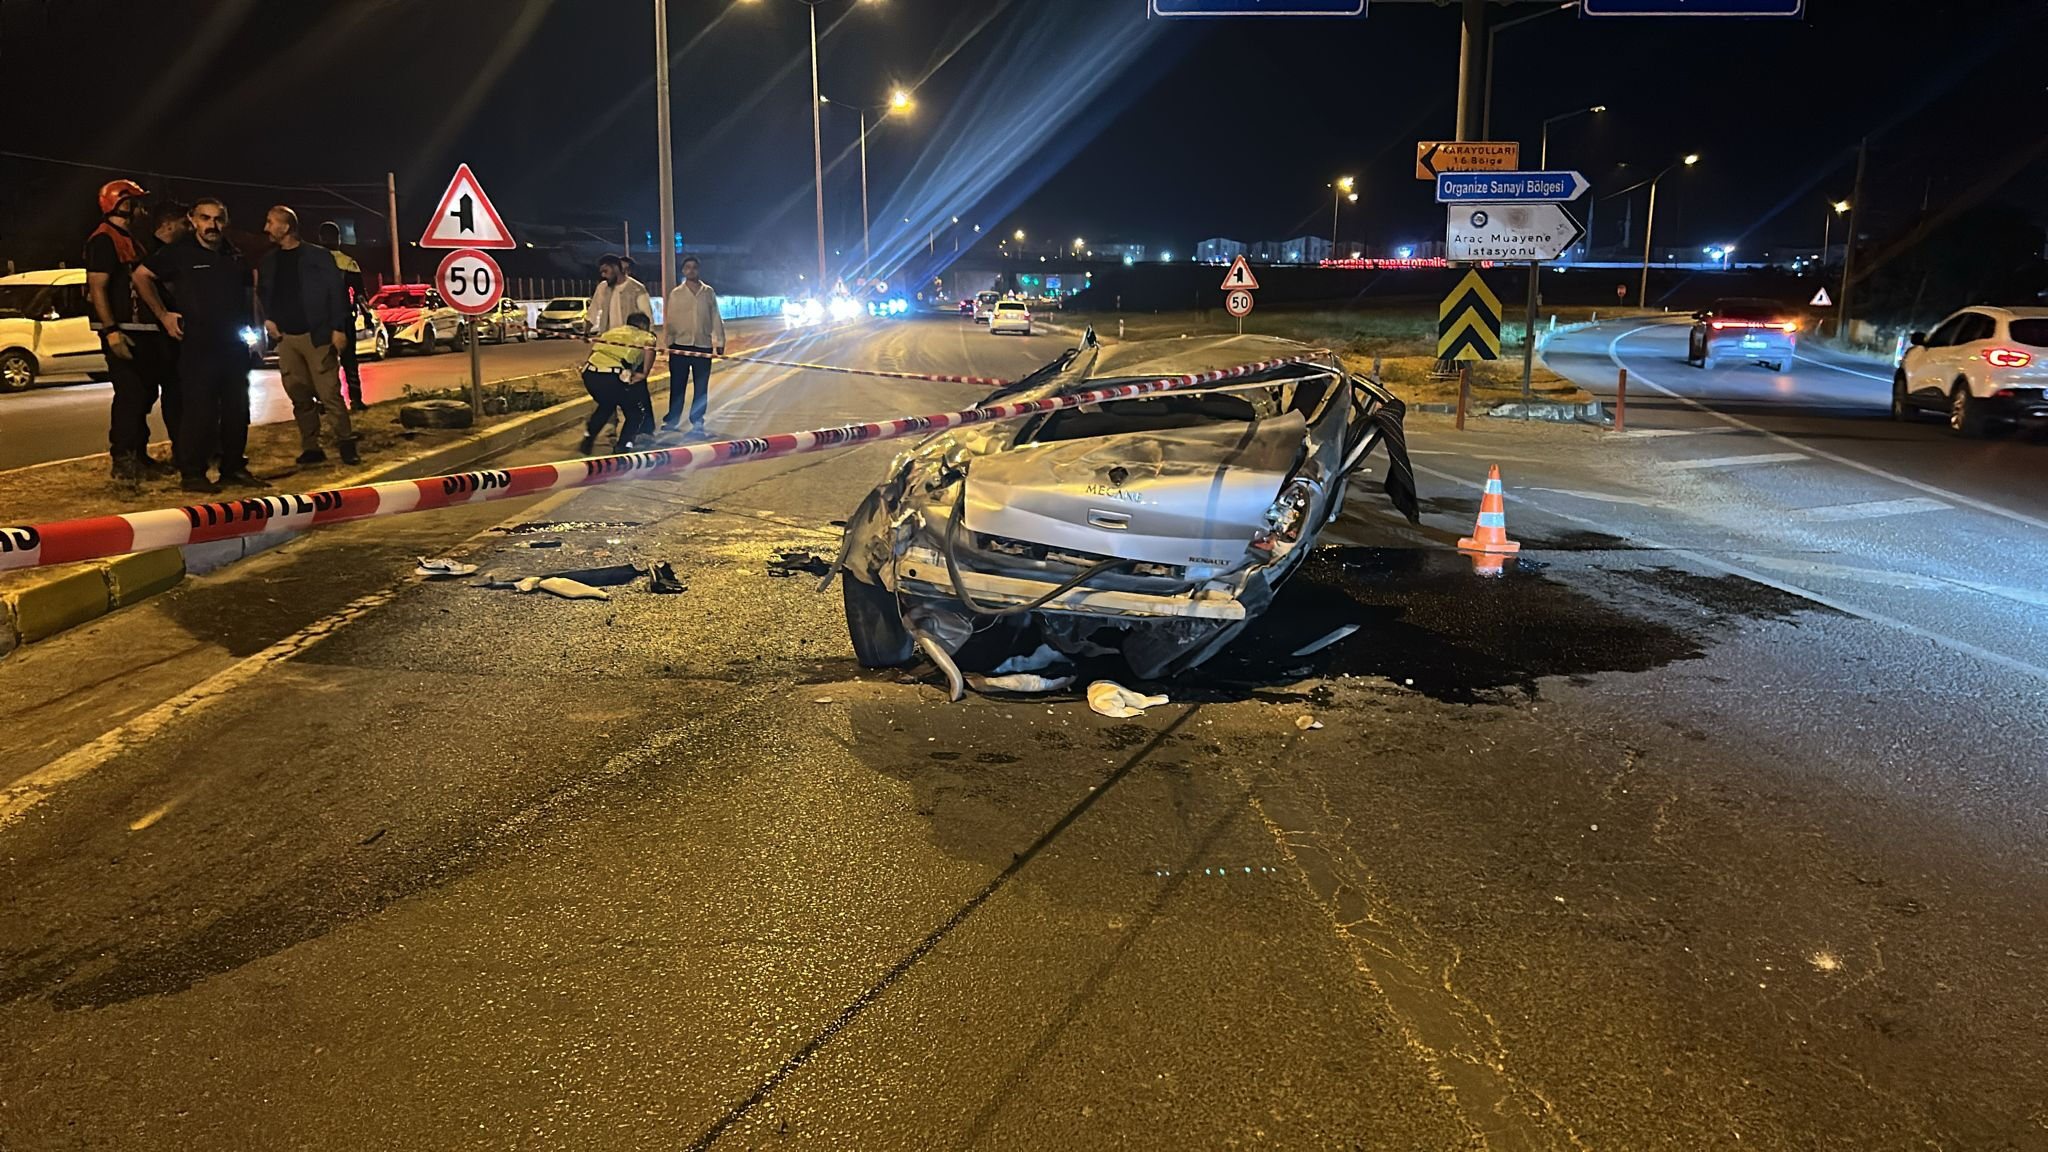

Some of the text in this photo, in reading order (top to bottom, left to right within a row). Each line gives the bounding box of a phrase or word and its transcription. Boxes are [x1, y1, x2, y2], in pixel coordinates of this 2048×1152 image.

[1442, 146, 1516, 155] KARAYOLLARI
[1444, 179, 1565, 197] Organize Sanayi Bölgesi
[1454, 234, 1552, 245] Araç Muayene
[450, 266, 491, 296] 50
[1232, 296, 1249, 309] 50
[1188, 556, 1232, 566] RENAULT
